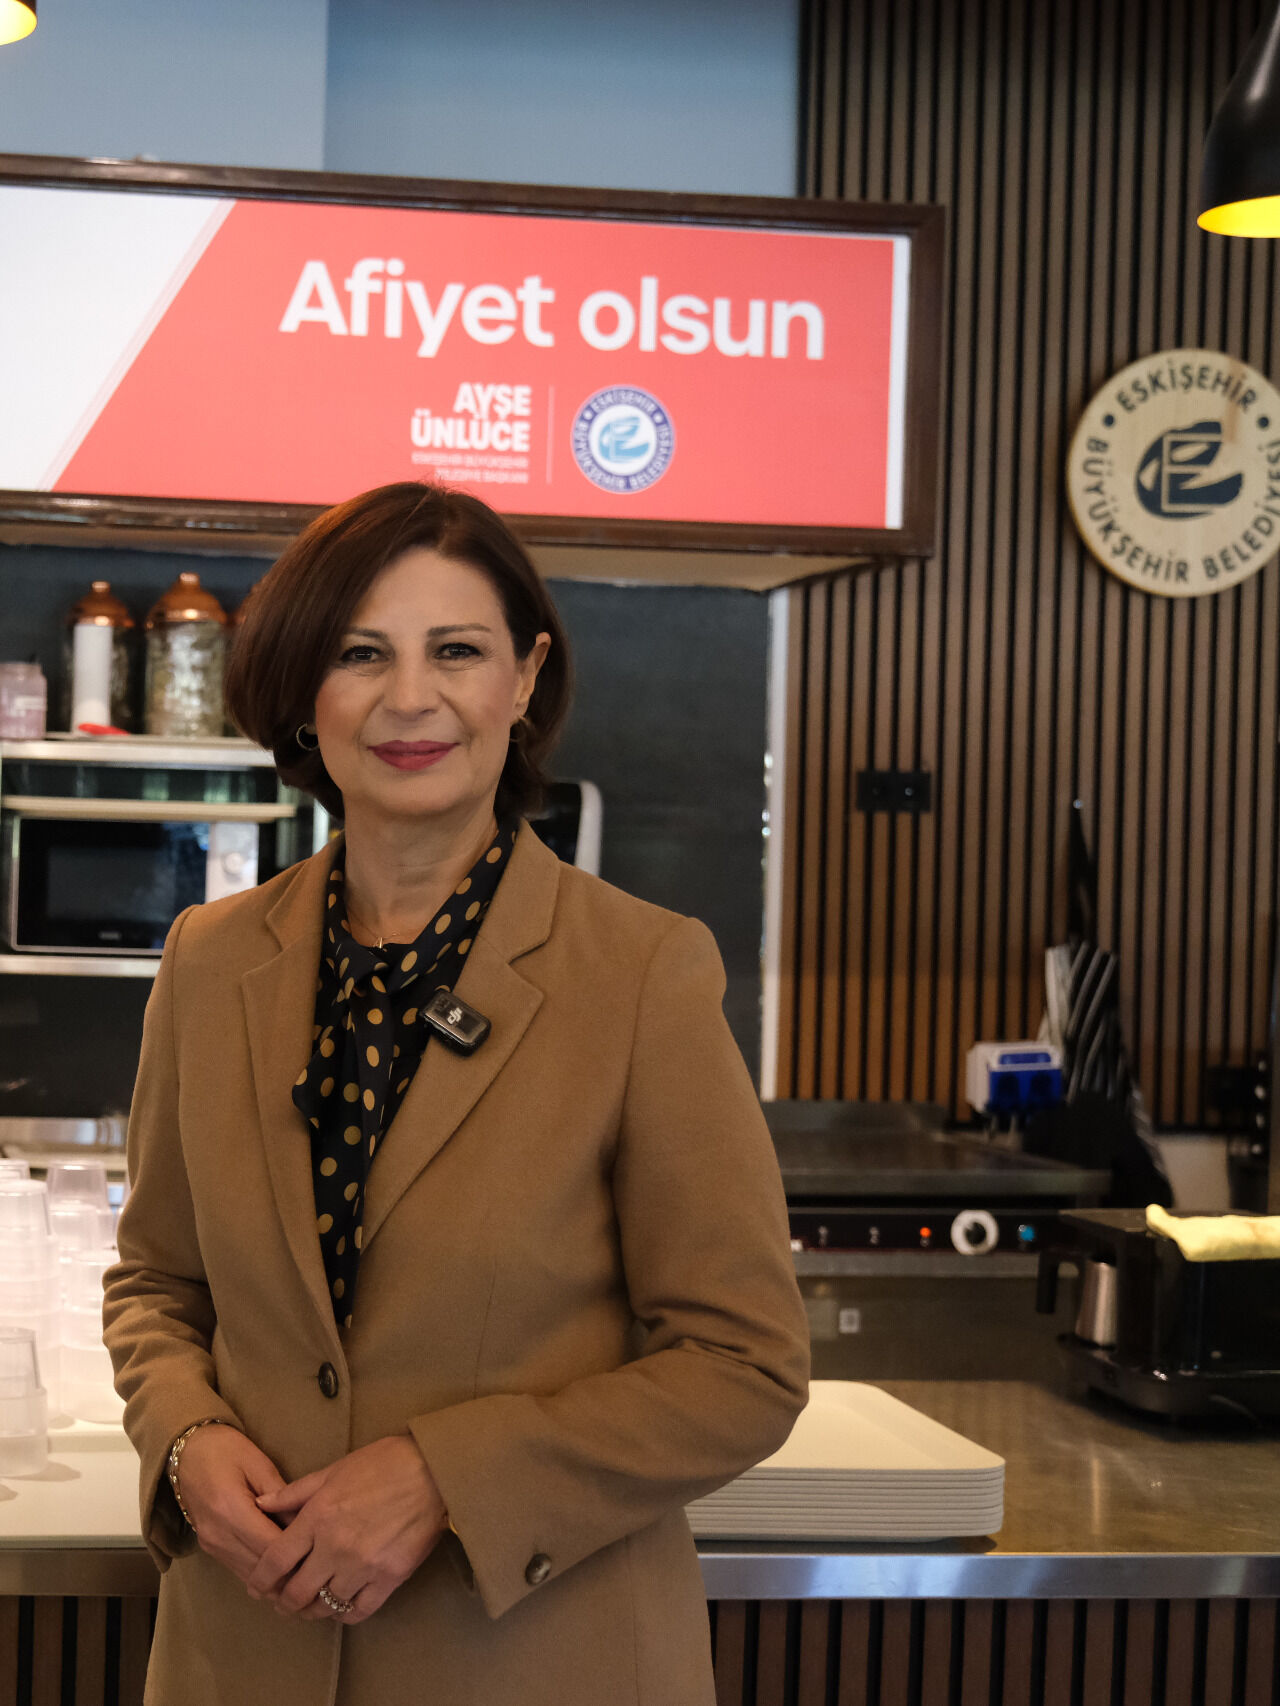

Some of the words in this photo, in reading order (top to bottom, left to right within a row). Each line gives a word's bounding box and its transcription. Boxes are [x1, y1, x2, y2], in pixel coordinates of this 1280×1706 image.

[279, 257, 555, 358] Afiyet
[579, 276, 824, 360] olsun
[1117, 358, 1258, 413] ESKİŞEHİR
[1082, 436, 1190, 584] BÜYÜKŞEHİR
